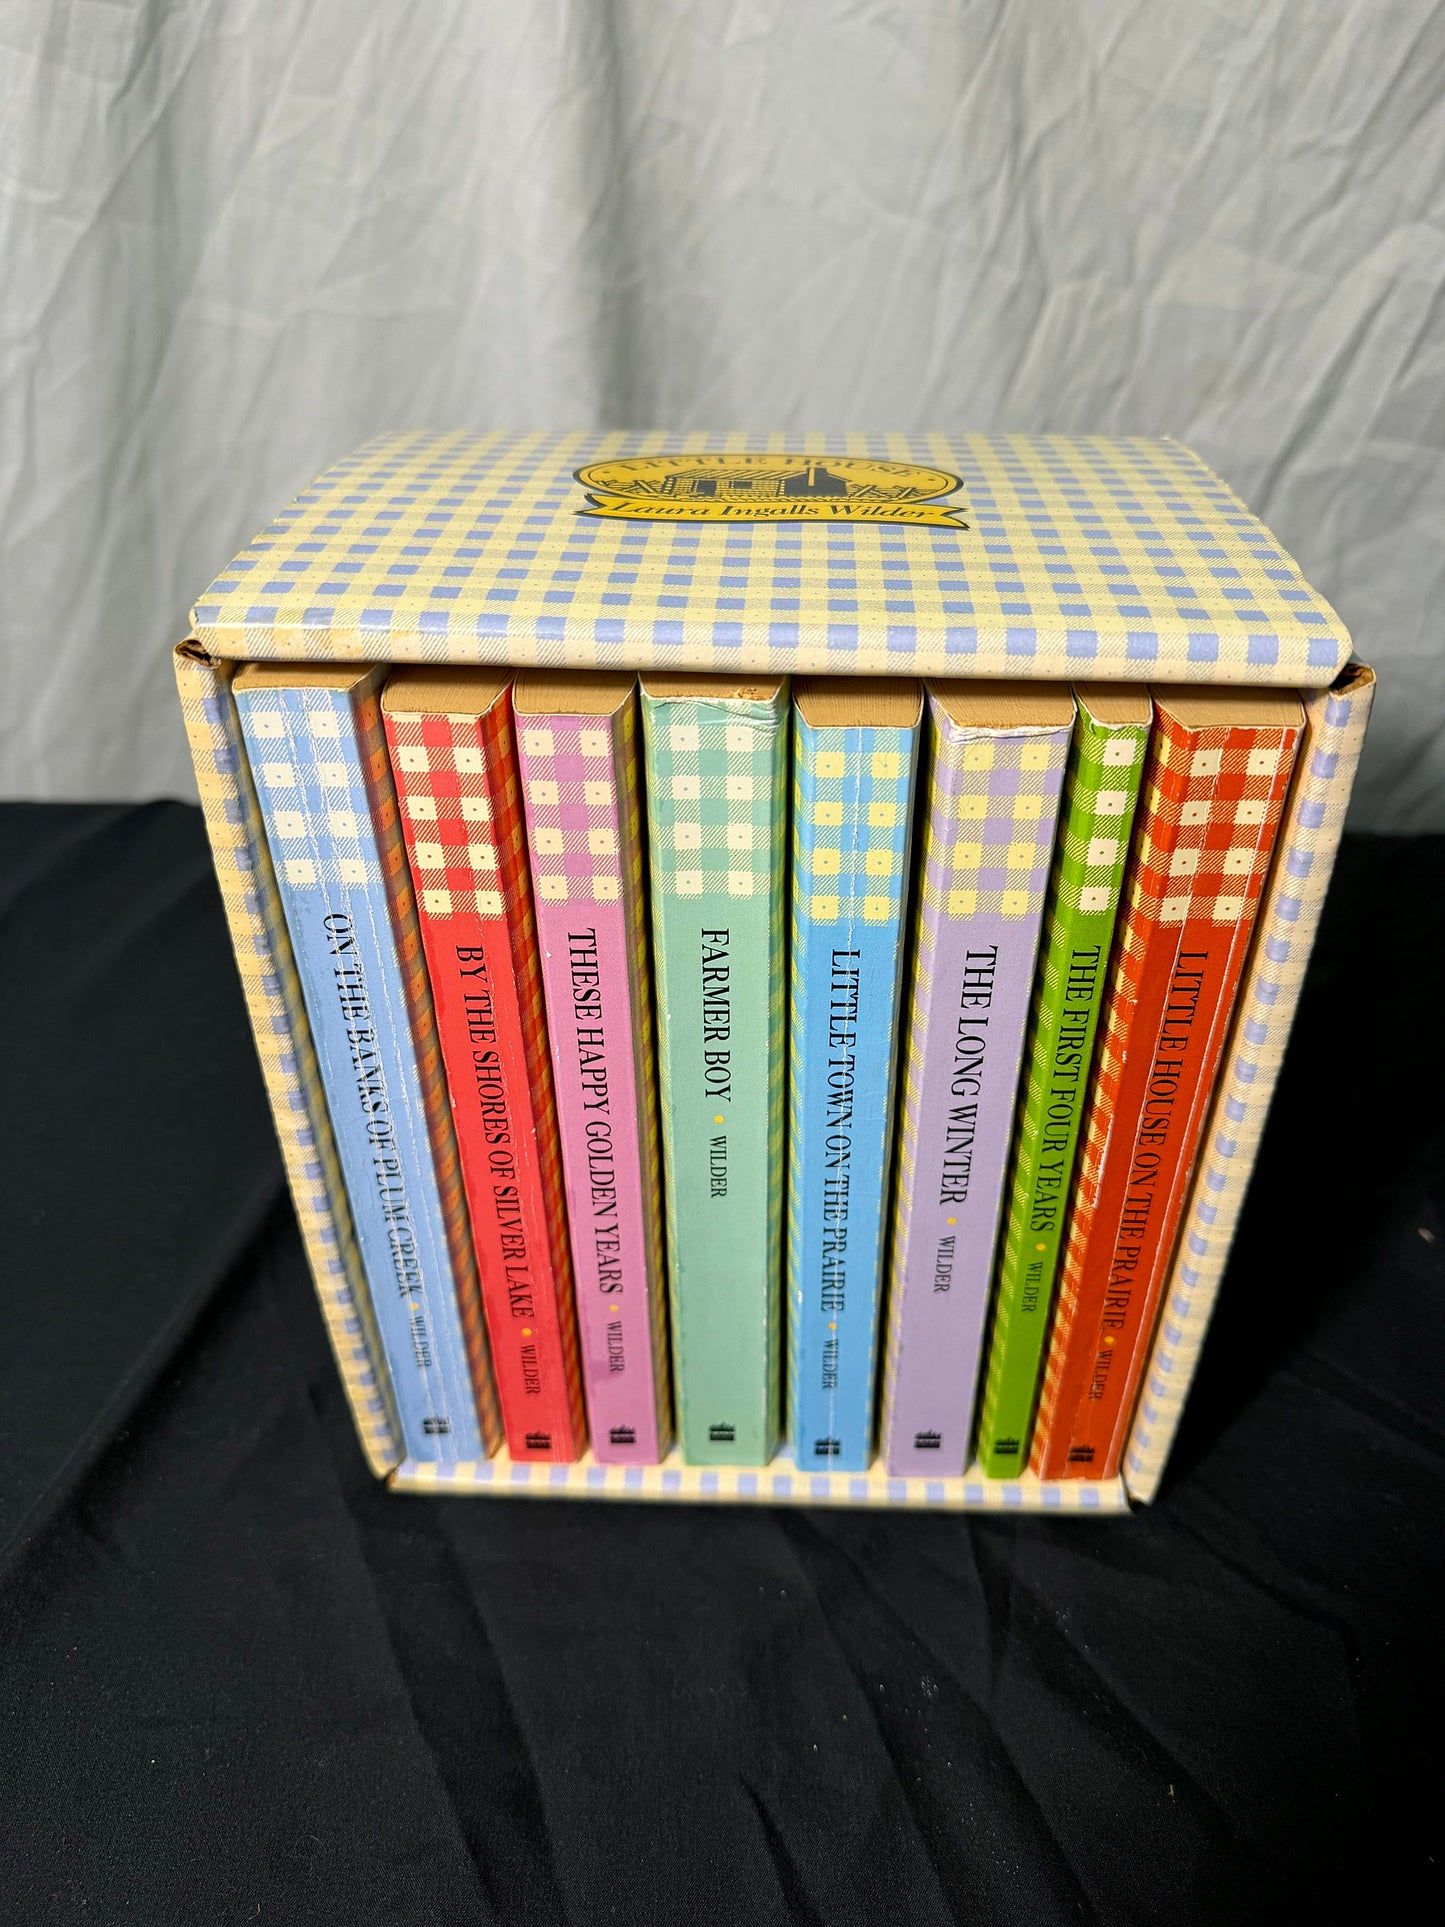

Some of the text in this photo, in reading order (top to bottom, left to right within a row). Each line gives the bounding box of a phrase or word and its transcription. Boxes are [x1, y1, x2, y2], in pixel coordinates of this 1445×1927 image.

[609, 502, 934, 519] Laura Ingalls Wilder
[619, 457, 921, 478] LITTLE HOUSE
[701, 927, 732, 1199] FARMER BOY WILDER
[1159, 950, 1208, 1053] LITTLE
[323, 913, 433, 1368] ON THE BANKS OF PLUM CREEK WILDER
[455, 944, 540, 1395] BY THE SHORES OF SILVER LAKE WILDER
[567, 927, 626, 1374] THESE HAPPY GOLDEN YEARS WILDER
[820, 947, 861, 1390] LITTLE TOWN ON THE PRAIRIE WILDER
[933, 944, 999, 1294] THE LONG WINTER WILDER
[1021, 944, 1102, 1314] THE FIRST FOUR YEARS WILDER
[1126, 1151, 1162, 1188] ON
[1137, 1057, 1184, 1146] HOUSE
[1101, 1242, 1142, 1331] PRAIRIE
[1117, 1191, 1153, 1241] THE
